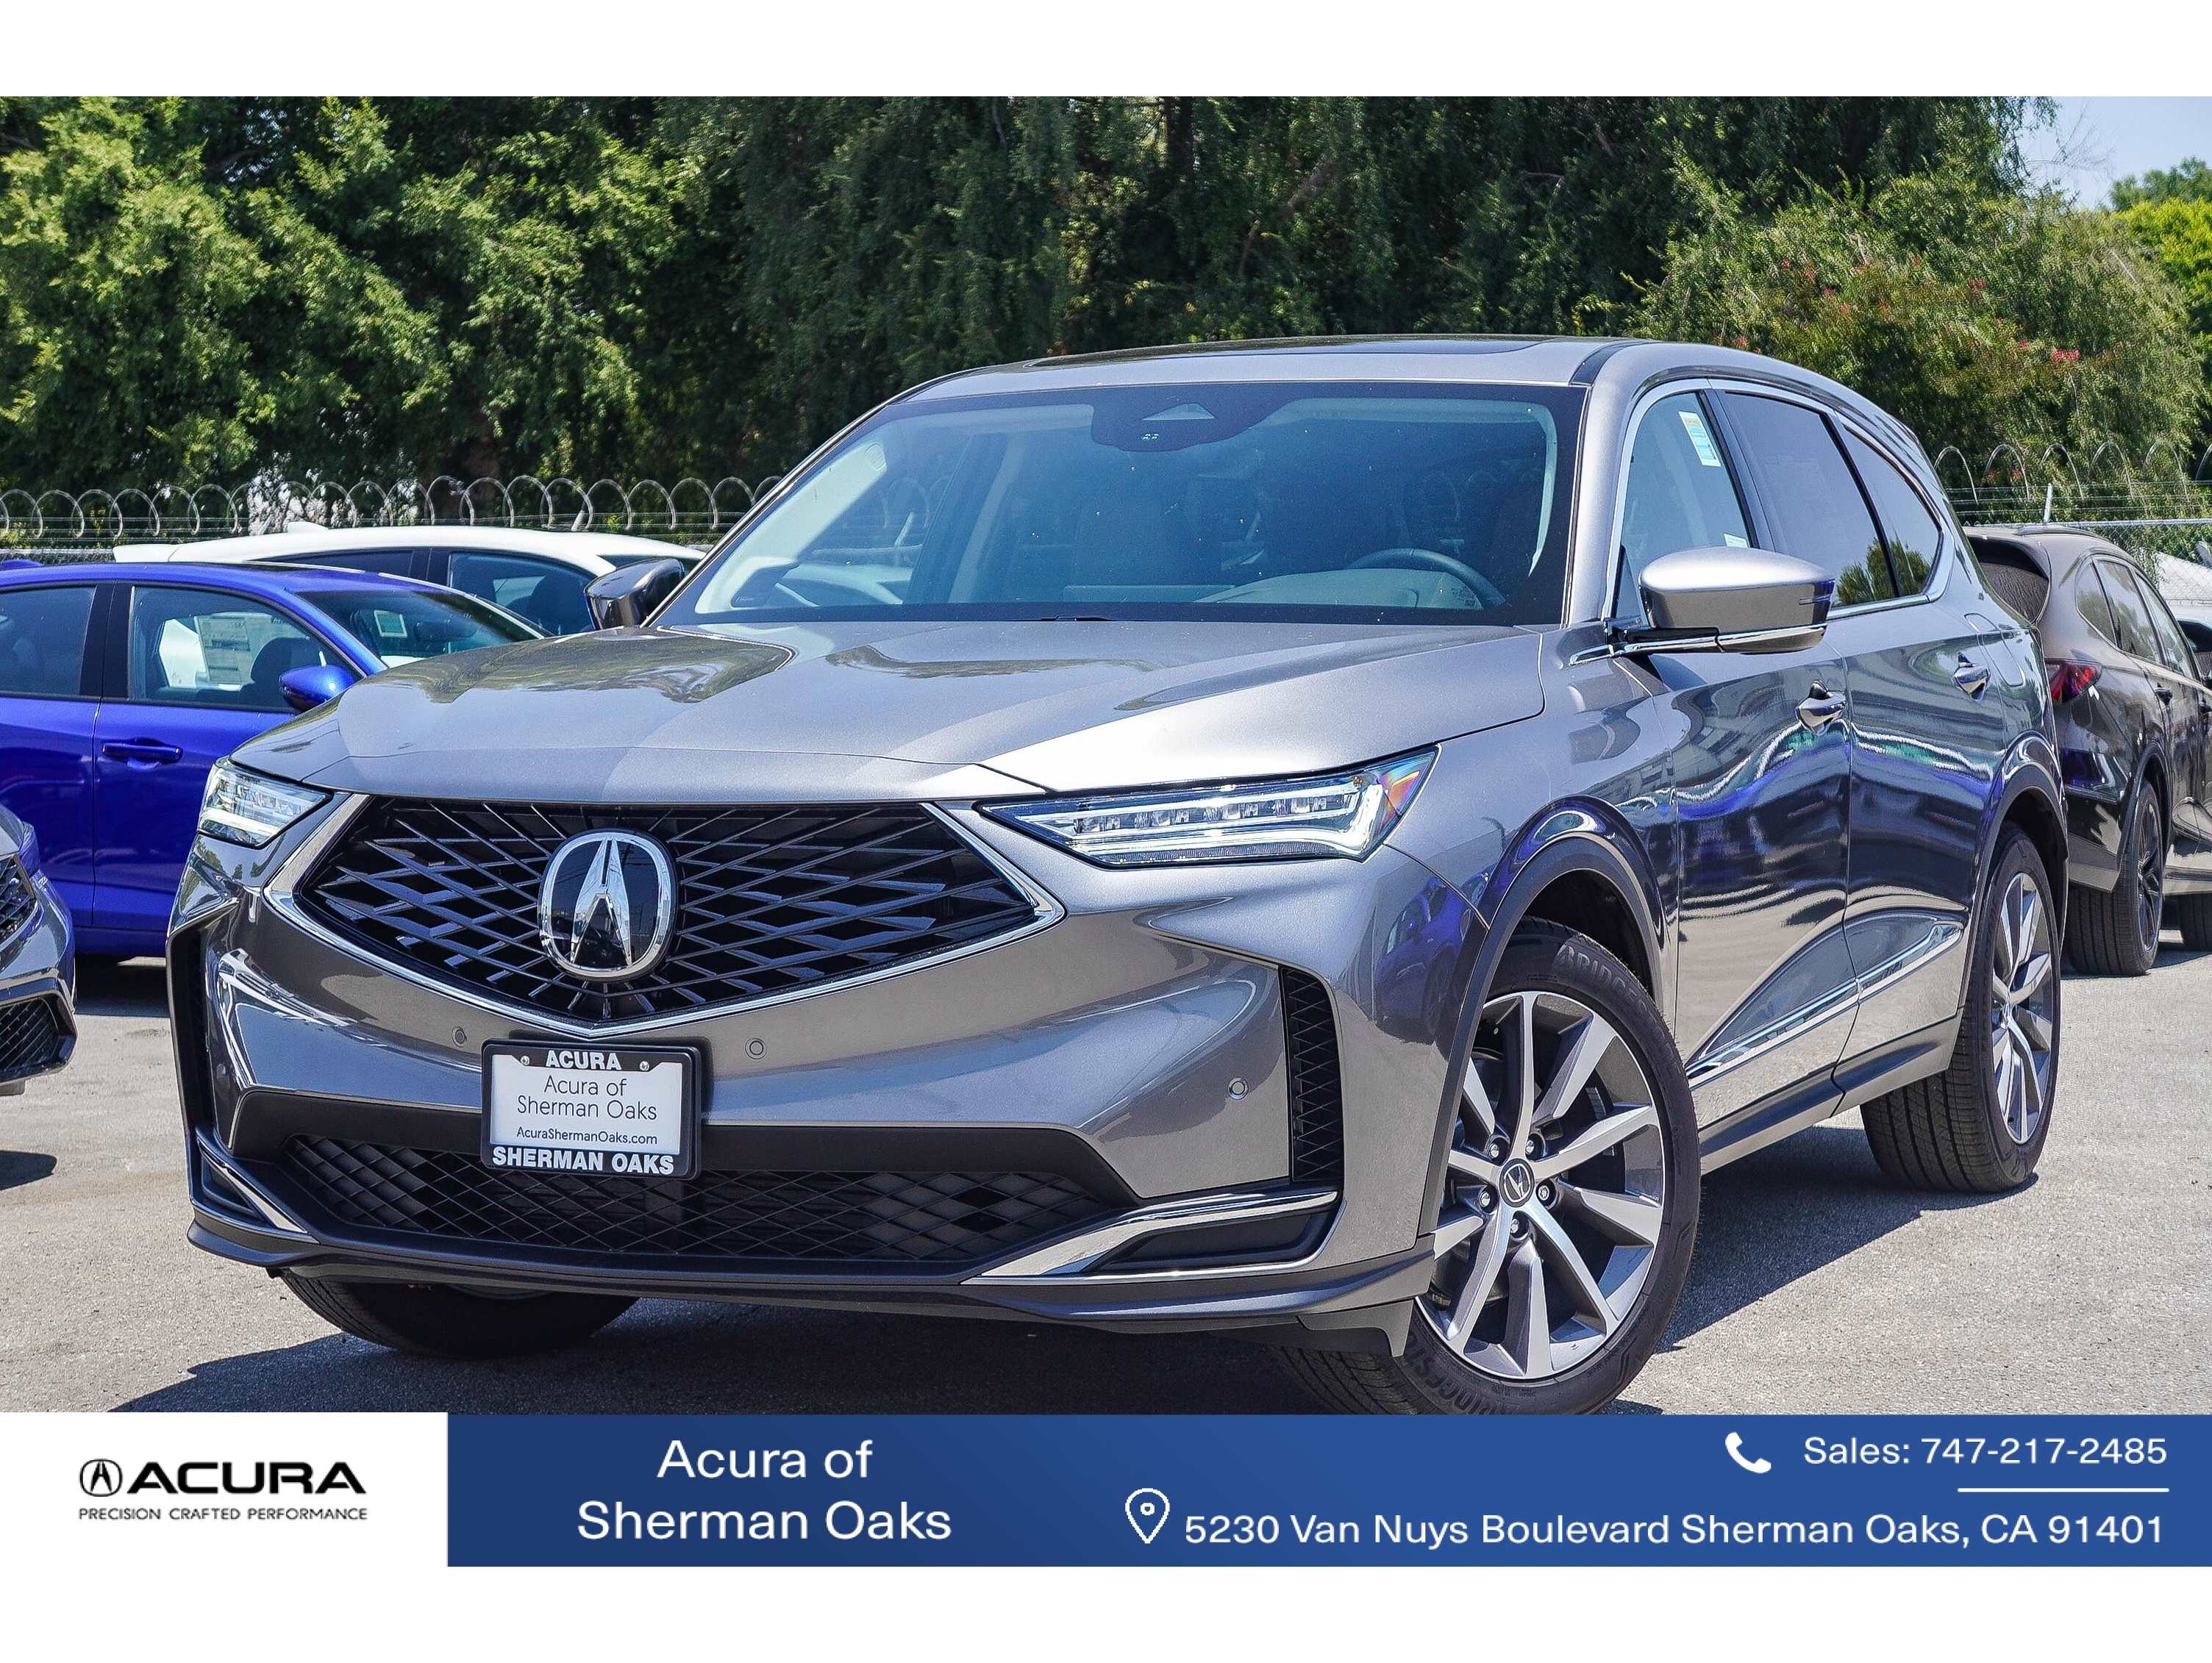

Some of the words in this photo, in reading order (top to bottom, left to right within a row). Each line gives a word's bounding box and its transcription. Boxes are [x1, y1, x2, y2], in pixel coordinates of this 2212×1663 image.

[546, 1050, 622, 1070] ACURA
[543, 1075, 599, 1095] Acura
[606, 1078, 627, 1097] of
[517, 1095, 599, 1117] Sherman
[607, 1099, 657, 1120] Oaks
[516, 1126, 658, 1145] AcuraShermanOaks.com
[492, 1146, 604, 1171] SHERMAN
[611, 1153, 674, 1176] OAKS
